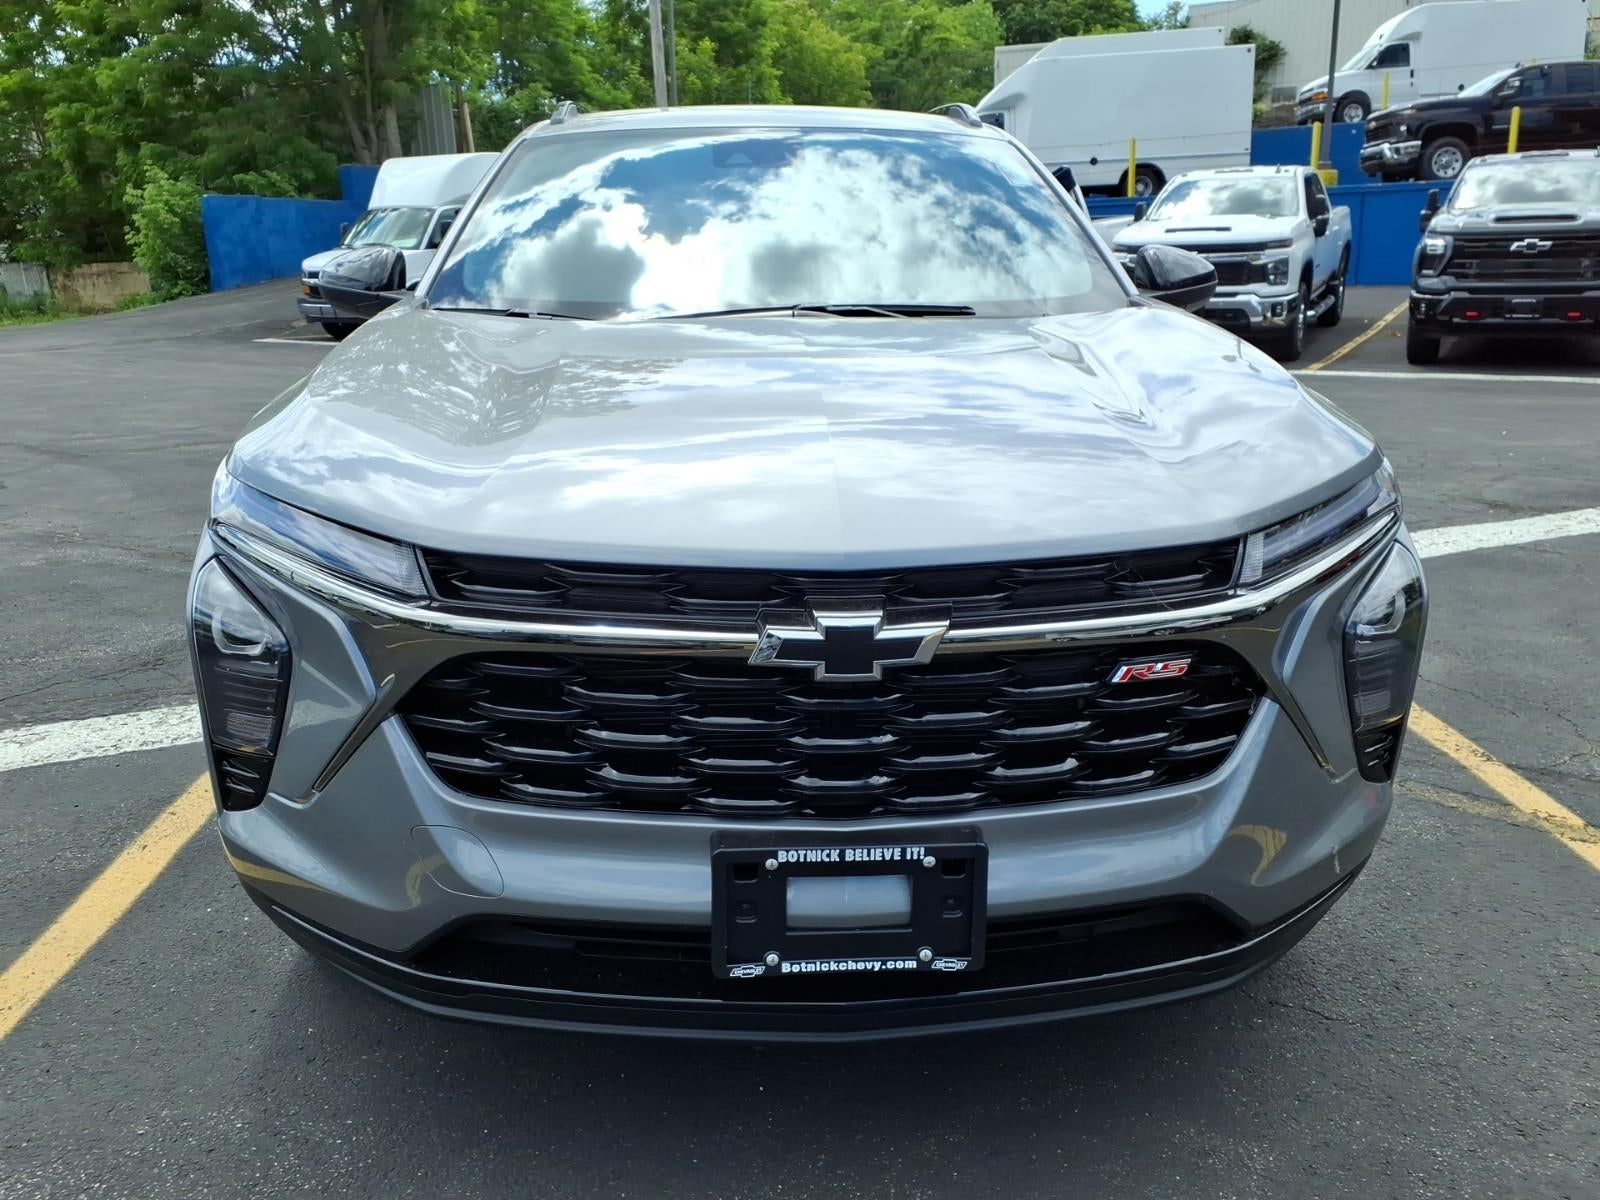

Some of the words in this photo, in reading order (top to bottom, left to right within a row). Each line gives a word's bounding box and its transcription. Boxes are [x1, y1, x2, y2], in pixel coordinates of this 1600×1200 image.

[1111, 658, 1192, 683] RS
[777, 849, 840, 863] BOTNICK
[845, 847, 902, 861] BELIEVE
[906, 847, 925, 860] IT!
[781, 960, 917, 973] Botnickchevy.com
